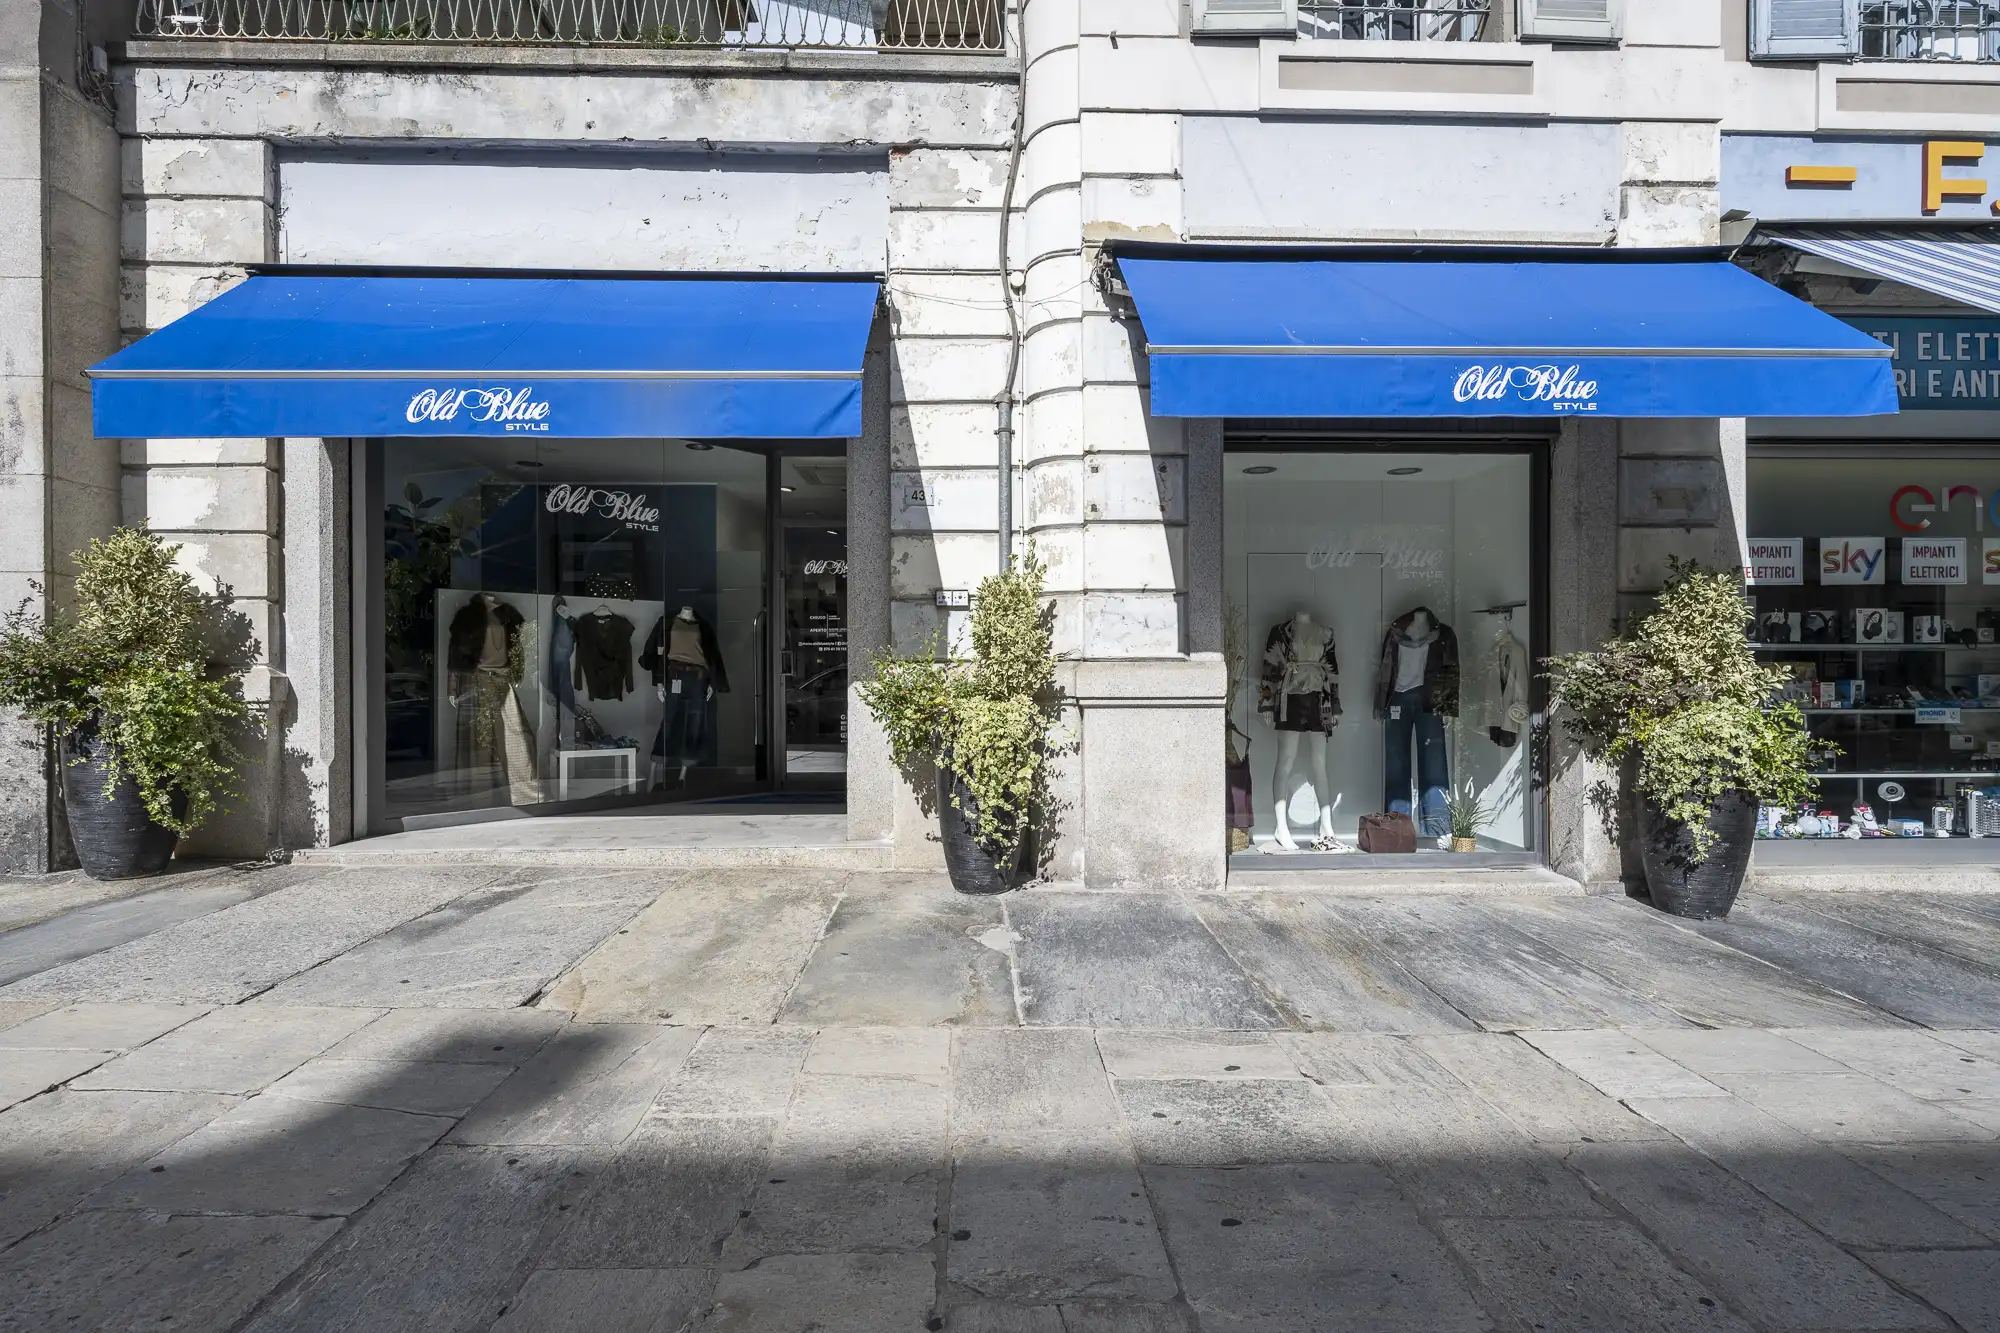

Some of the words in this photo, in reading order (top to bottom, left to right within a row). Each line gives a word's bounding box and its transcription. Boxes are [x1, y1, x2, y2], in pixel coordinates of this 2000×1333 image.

[1864, 331, 1900, 360] TI
[1453, 364, 1508, 402] Old
[1513, 364, 1598, 401] Blue
[1928, 369, 1942, 397] E
[405, 387, 466, 423] Old
[469, 387, 550, 422] Blue
[1553, 402, 1598, 410] STYLE
[505, 423, 550, 431] STYLE
[911, 490, 926, 501] 43
[545, 484, 593, 516] Old
[597, 490, 660, 522] Blue
[1889, 485, 2000, 533] en
[625, 522, 660, 532] STYLE
[1748, 546, 1792, 559] IMPIANTI
[1912, 545, 1956, 559] IMPIANTI
[804, 560, 827, 575] Old
[1822, 541, 1884, 581] sky
[1745, 566, 1795, 578] ELETTRICI
[1910, 566, 1959, 578] ELETTRICI
